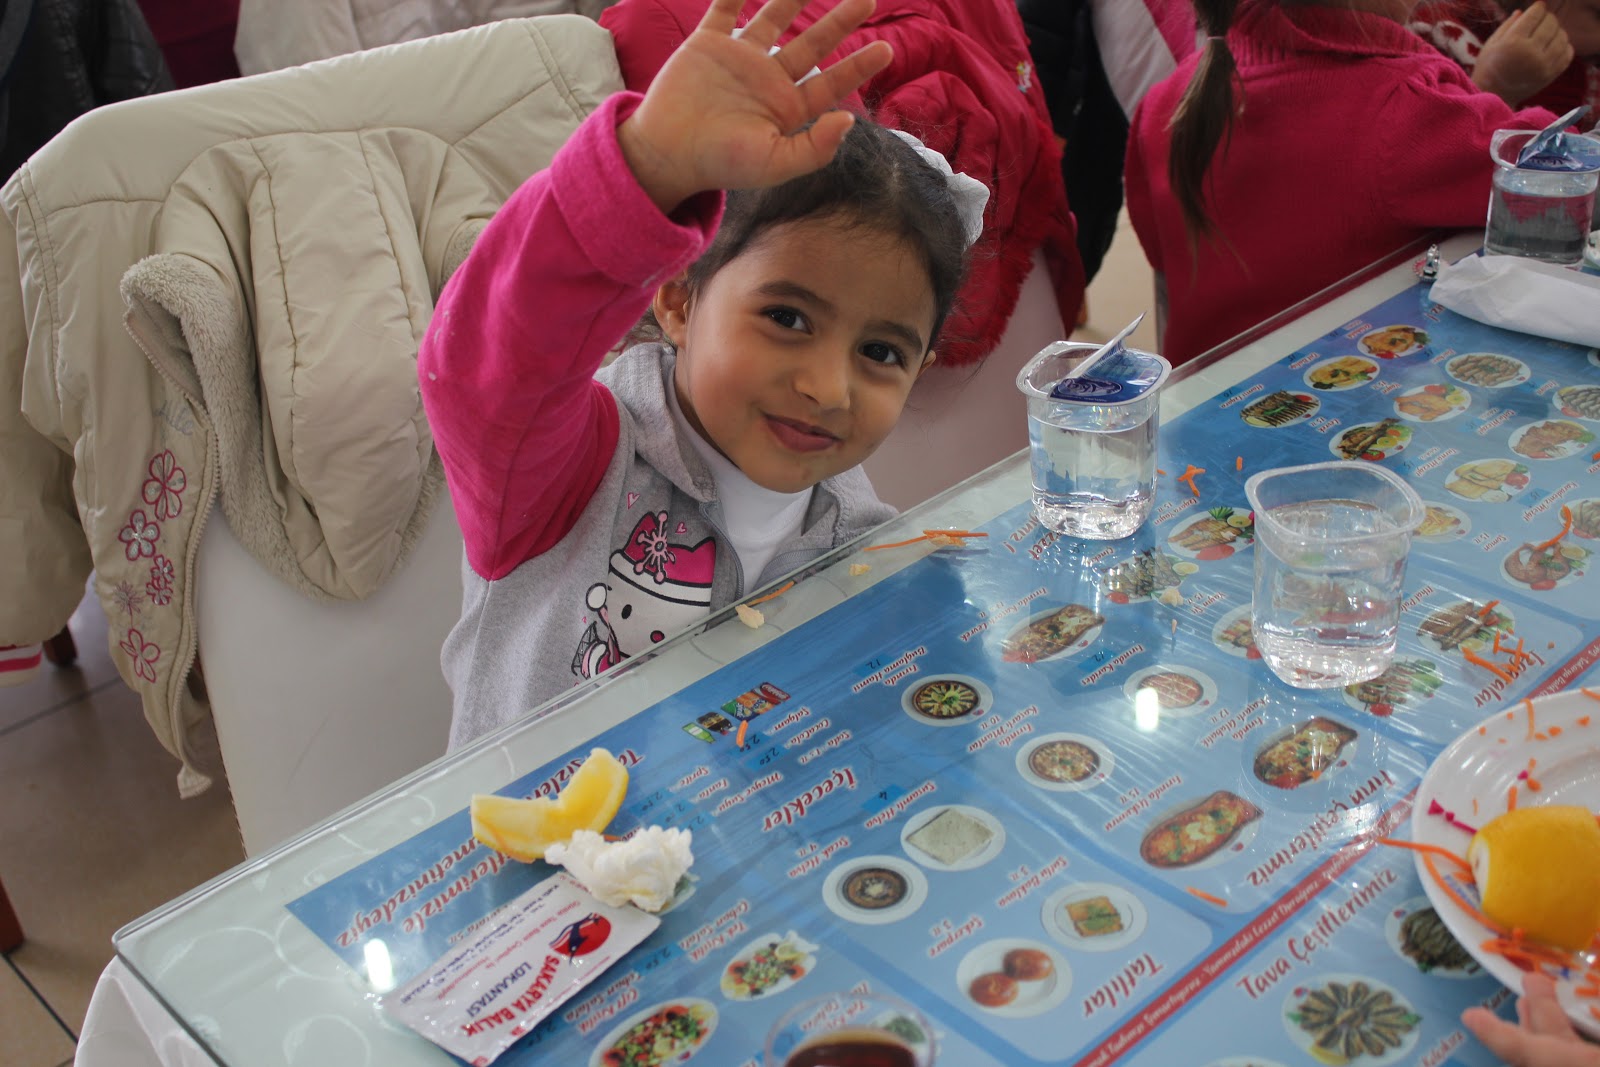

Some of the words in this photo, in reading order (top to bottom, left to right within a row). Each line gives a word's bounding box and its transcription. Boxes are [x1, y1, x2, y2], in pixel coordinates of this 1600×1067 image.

[1243, 383, 1263, 397] Hamsi
[1317, 417, 1340, 433] Levrek
[1544, 481, 1577, 505] Karadeniz
[1522, 502, 1546, 522] Mezgit
[1482, 533, 1504, 552] Somon
[959, 621, 987, 642] Levrek
[864, 657, 881, 671] 12
[1112, 644, 1144, 666] Fırında
[852, 670, 883, 693] Hamsi
[884, 663, 918, 687] Fırında
[1080, 662, 1114, 686] Karides
[789, 718, 830, 746] CocaCola
[826, 730, 851, 748] Soda
[967, 724, 1007, 753] Mantar
[998, 722, 1033, 748] Fırında
[678, 765, 709, 787] Sprite
[745, 771, 782, 797] Meyve
[1147, 775, 1182, 800] Fırında
[1349, 768, 1392, 807] Fırın
[698, 778, 729, 800] Fanta
[761, 765, 857, 833] İçecekler
[895, 781, 936, 811] Susamlı
[865, 806, 895, 829] Helva
[821, 836, 850, 859] Sıcak
[788, 854, 820, 878] Helva
[997, 874, 1041, 908] Baklava
[1235, 956, 1291, 1000] Tava
[1285, 866, 1396, 964] Çeşitlerimiz
[466, 961, 532, 1018] LOKANTASI
[511, 953, 561, 1014] SAKARYA
[1081, 951, 1162, 1018] Tatlılar
[461, 1006, 515, 1038] BALIK
